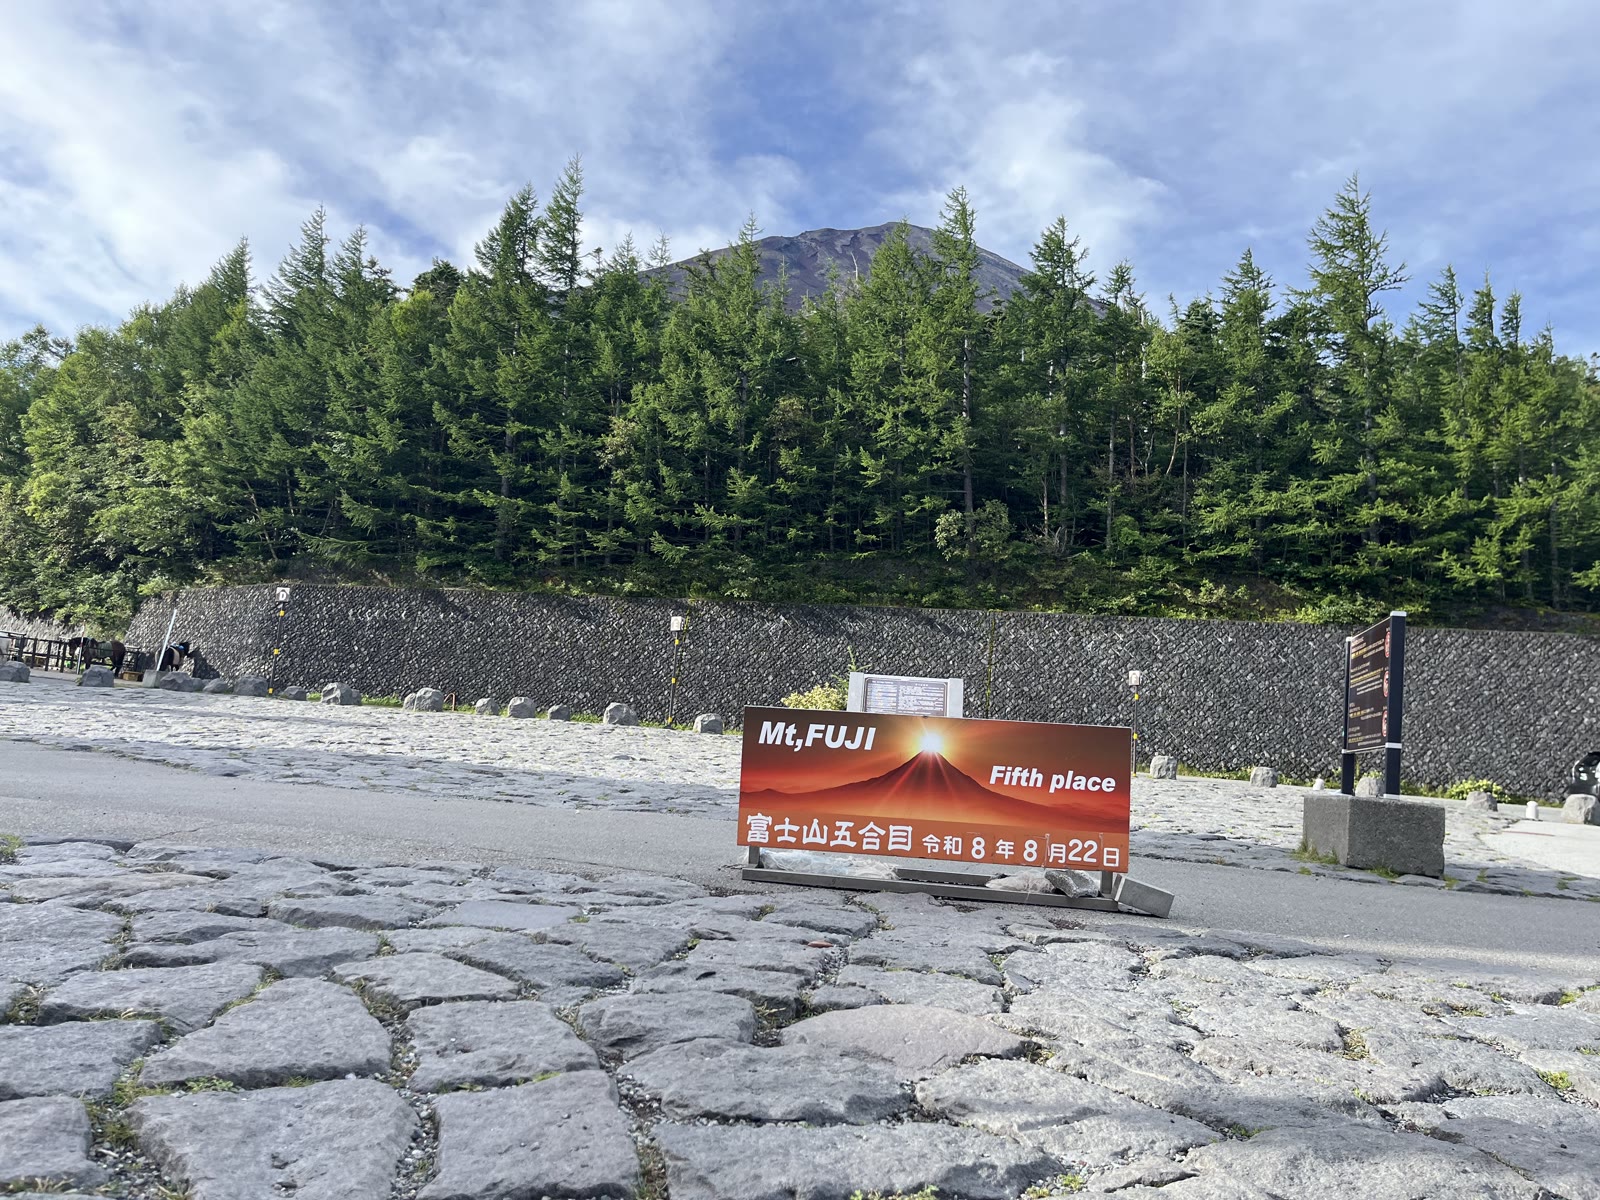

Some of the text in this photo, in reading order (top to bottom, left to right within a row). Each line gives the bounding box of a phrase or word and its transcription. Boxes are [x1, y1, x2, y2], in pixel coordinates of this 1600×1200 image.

[279, 591, 287, 601] D
[758, 721, 876, 752] Mt,FUJI
[989, 765, 1116, 794] Fifth place
[747, 812, 913, 852] 富士山五合目
